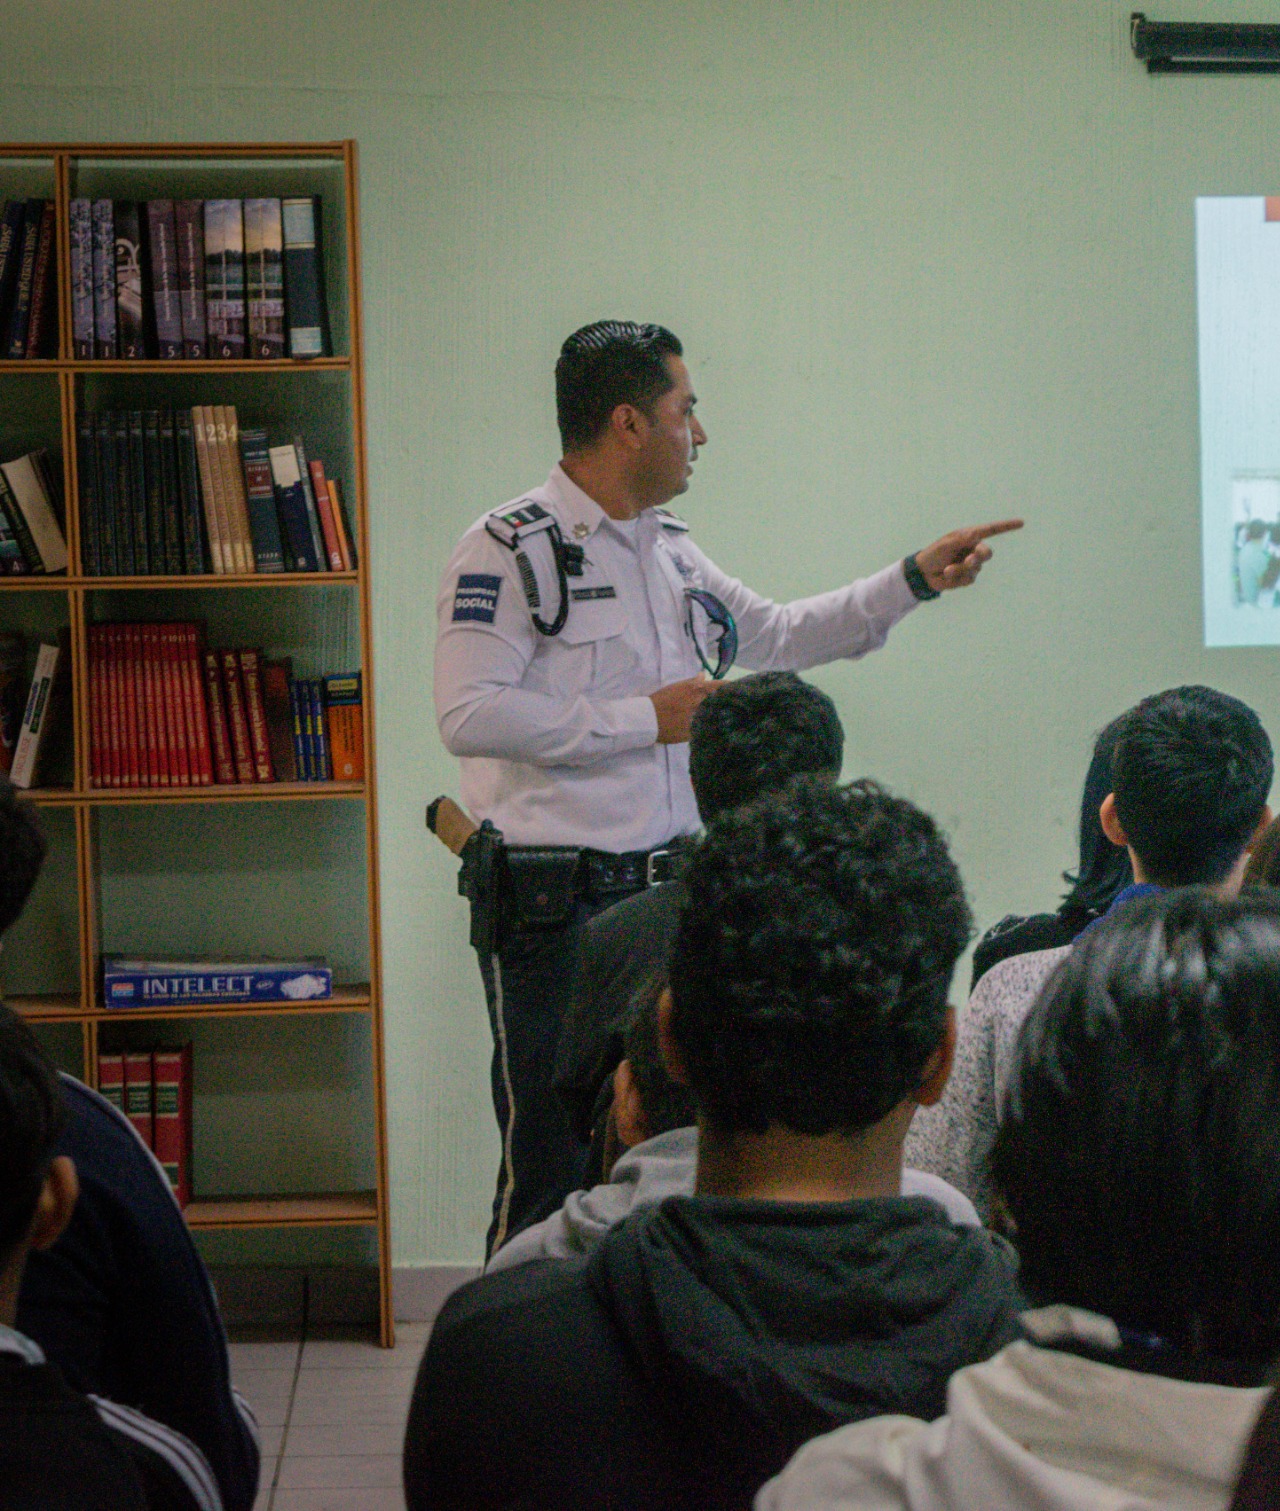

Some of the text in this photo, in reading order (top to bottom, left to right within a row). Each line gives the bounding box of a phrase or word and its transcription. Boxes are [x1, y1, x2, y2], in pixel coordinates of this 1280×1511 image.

[127, 345, 136, 357] 2
[167, 344, 175, 357] 5
[192, 344, 201, 357] 5
[222, 344, 231, 357] 6
[261, 343, 270, 356] 6
[195, 423, 204, 442] 1
[205, 423, 217, 442] 2
[217, 423, 228, 442] 3
[226, 423, 238, 442] 4
[455, 597, 496, 611] SOCIAL
[142, 976, 253, 994] INTELECT
